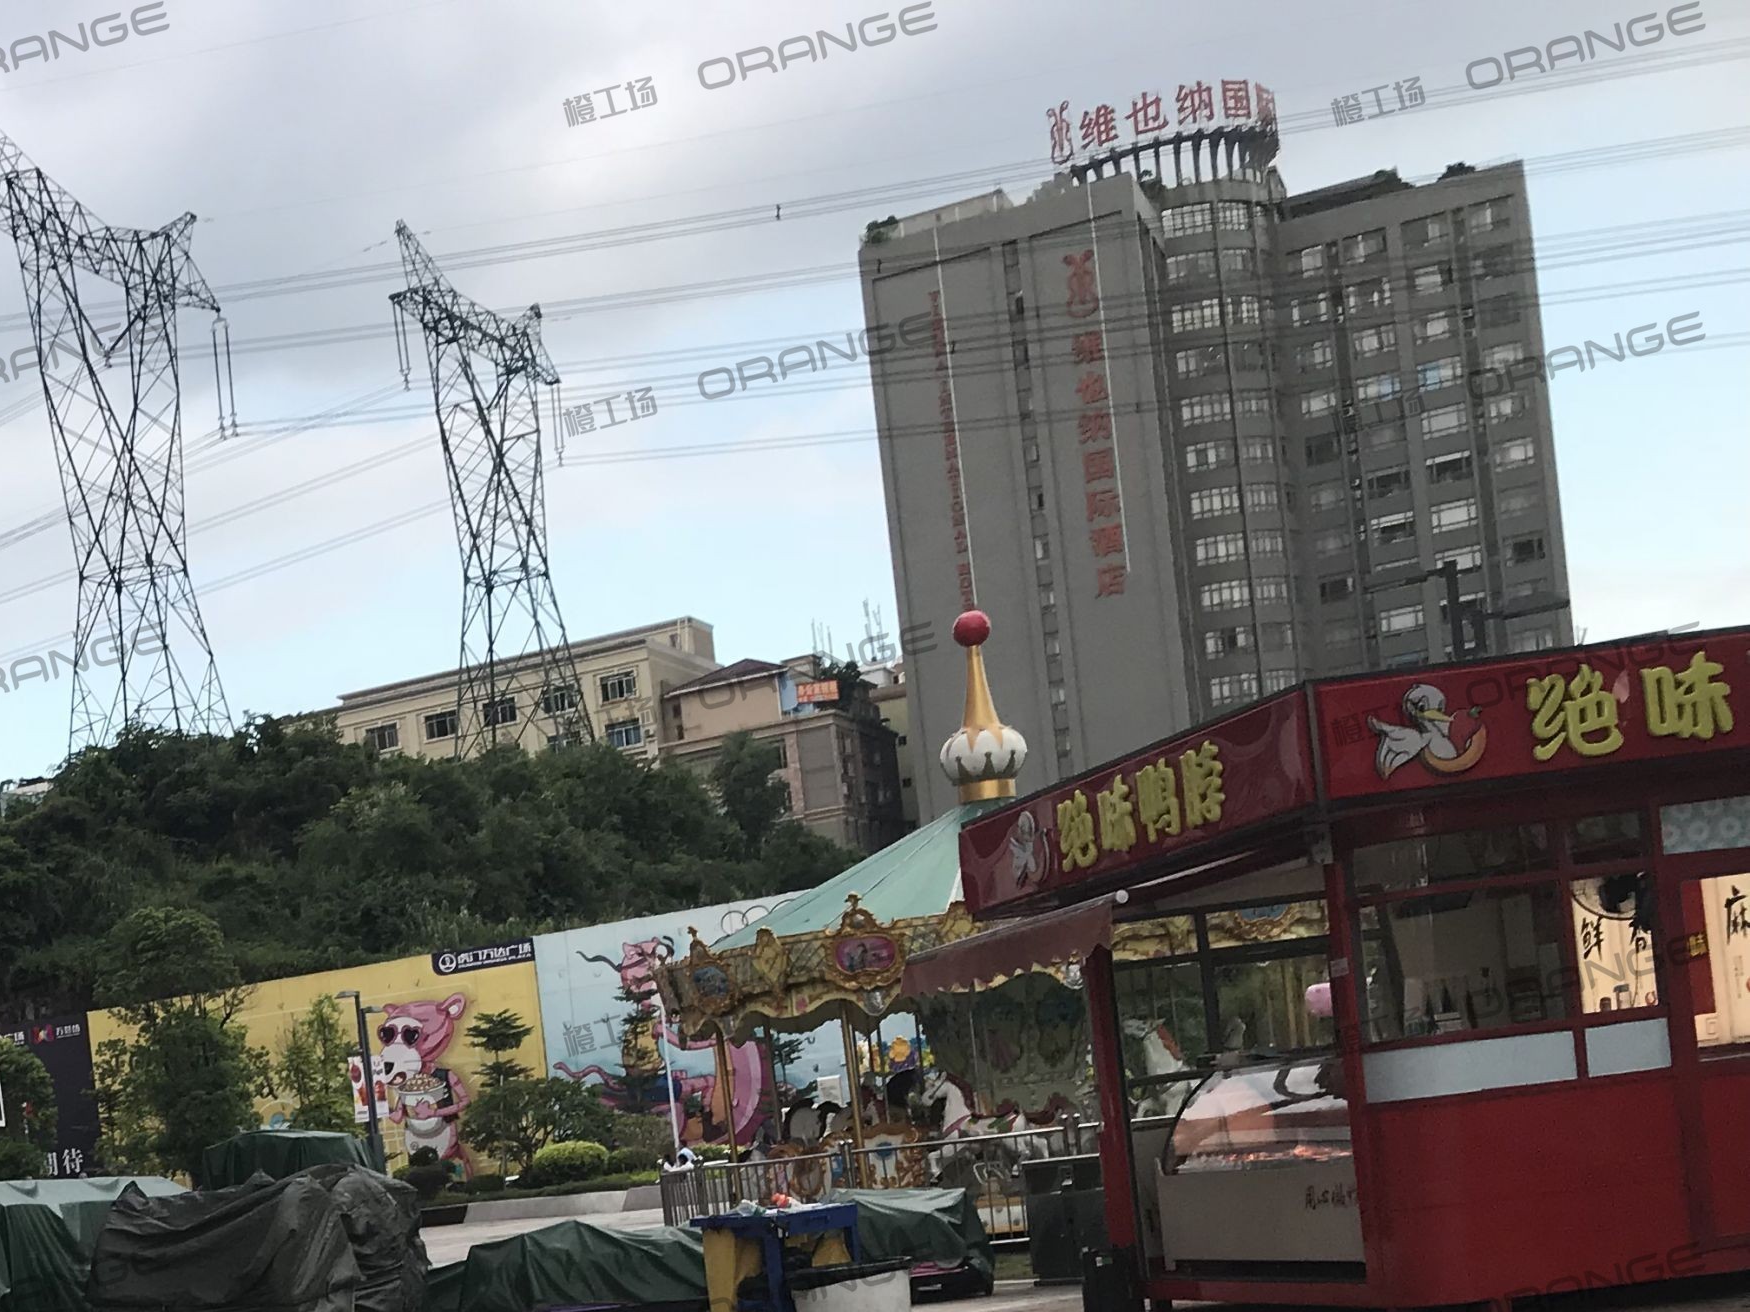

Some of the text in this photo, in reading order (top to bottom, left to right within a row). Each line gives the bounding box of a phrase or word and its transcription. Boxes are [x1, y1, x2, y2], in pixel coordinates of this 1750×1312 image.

[1525, 650, 1735, 762] 绝味
[1056, 739, 1227, 874] 绝味鸭脖
